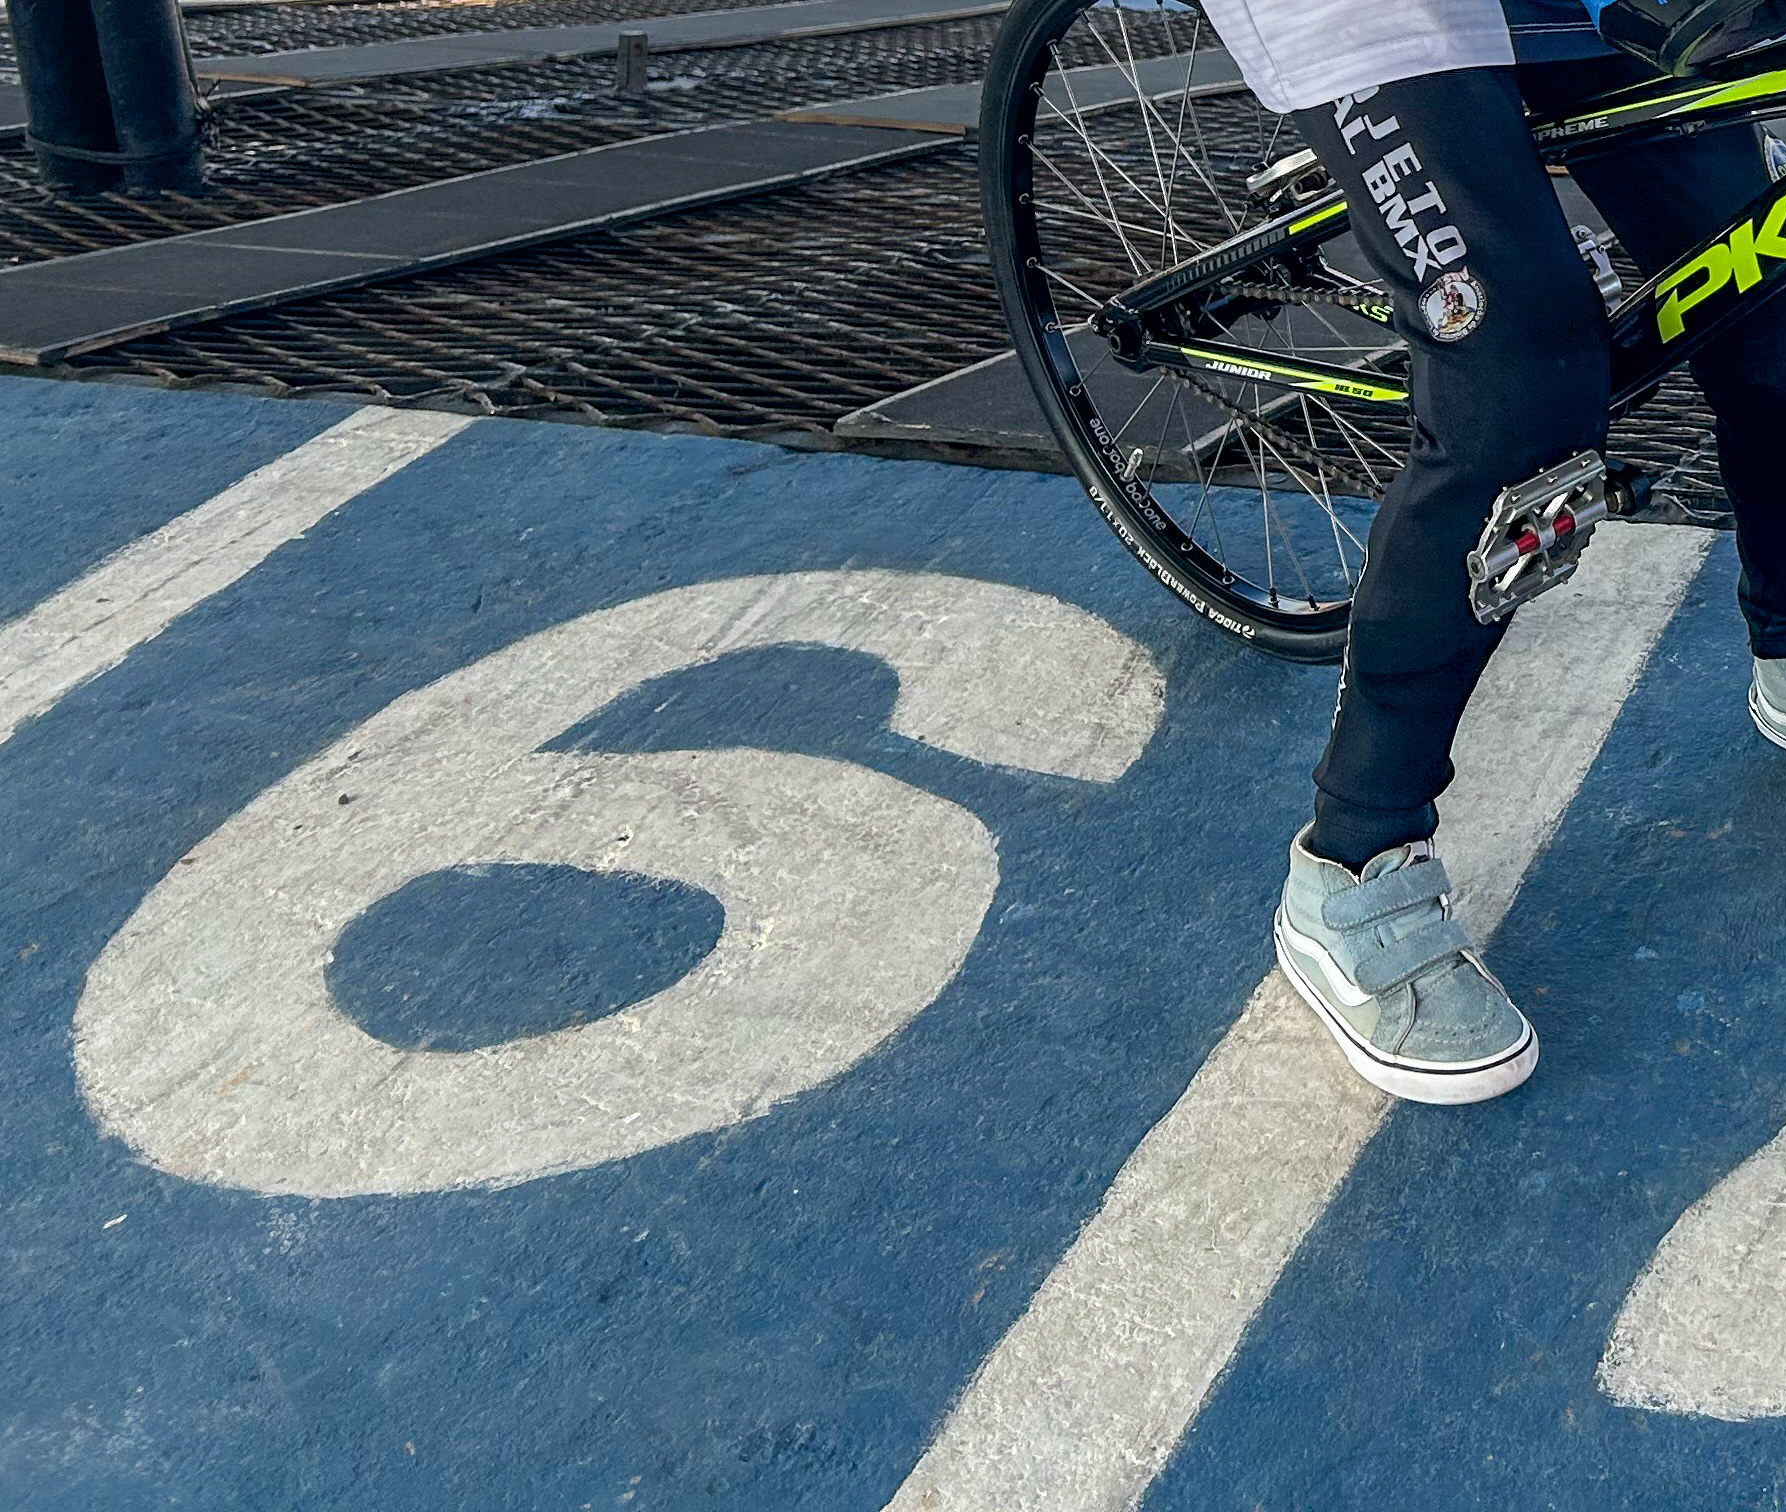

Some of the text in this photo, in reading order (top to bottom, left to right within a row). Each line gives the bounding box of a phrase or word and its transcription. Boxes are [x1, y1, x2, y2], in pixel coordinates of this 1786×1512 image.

[1362, 159, 1443, 284] BMX
[1205, 361, 1272, 381] JUNIOR
[1208, 607, 1242, 635] TIOGA
[74, 566, 1169, 1203] 6
